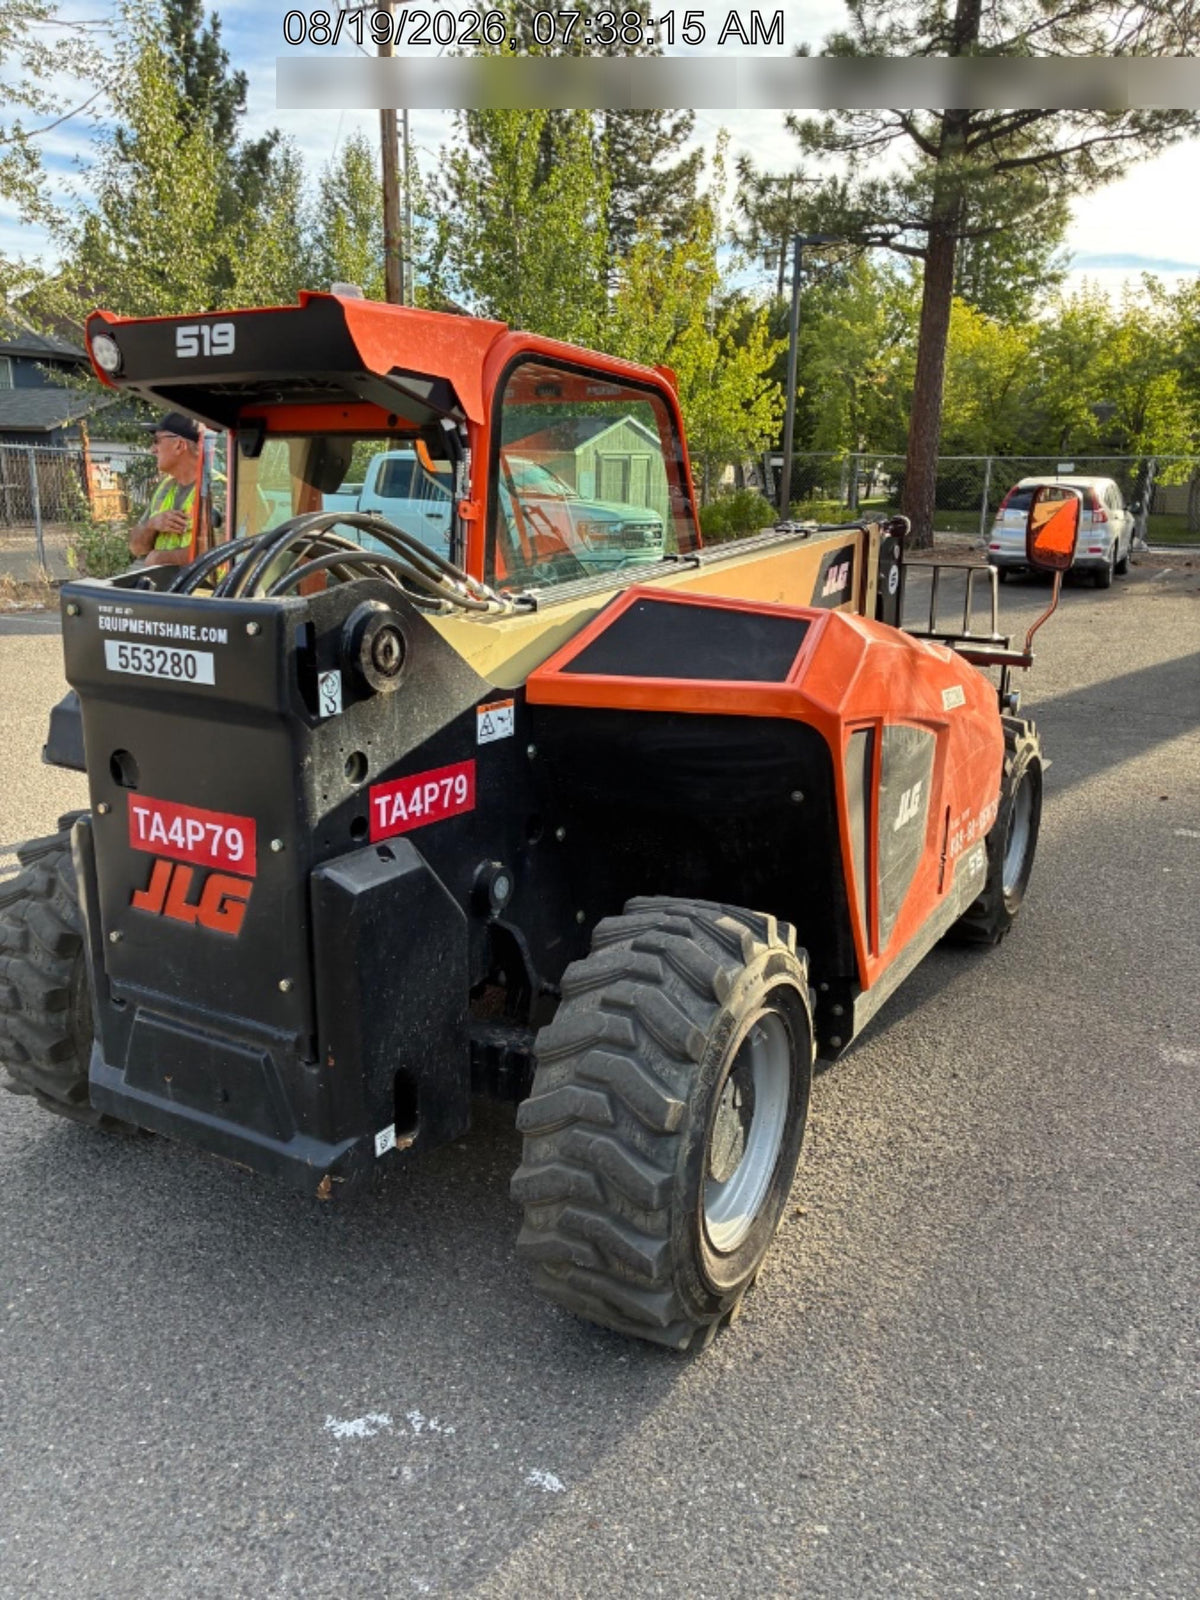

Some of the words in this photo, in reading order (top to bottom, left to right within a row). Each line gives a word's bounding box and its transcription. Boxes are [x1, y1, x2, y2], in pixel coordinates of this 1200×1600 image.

[175, 322, 236, 359] 519
[821, 560, 850, 598] JLG
[98, 615, 228, 644] EQUIPMENTSHARE.COM
[117, 645, 197, 679] 553280
[373, 773, 469, 829] TA4P79
[893, 780, 923, 833] JLG
[132, 806, 245, 862] TA4P79
[130, 858, 254, 938] JLG
